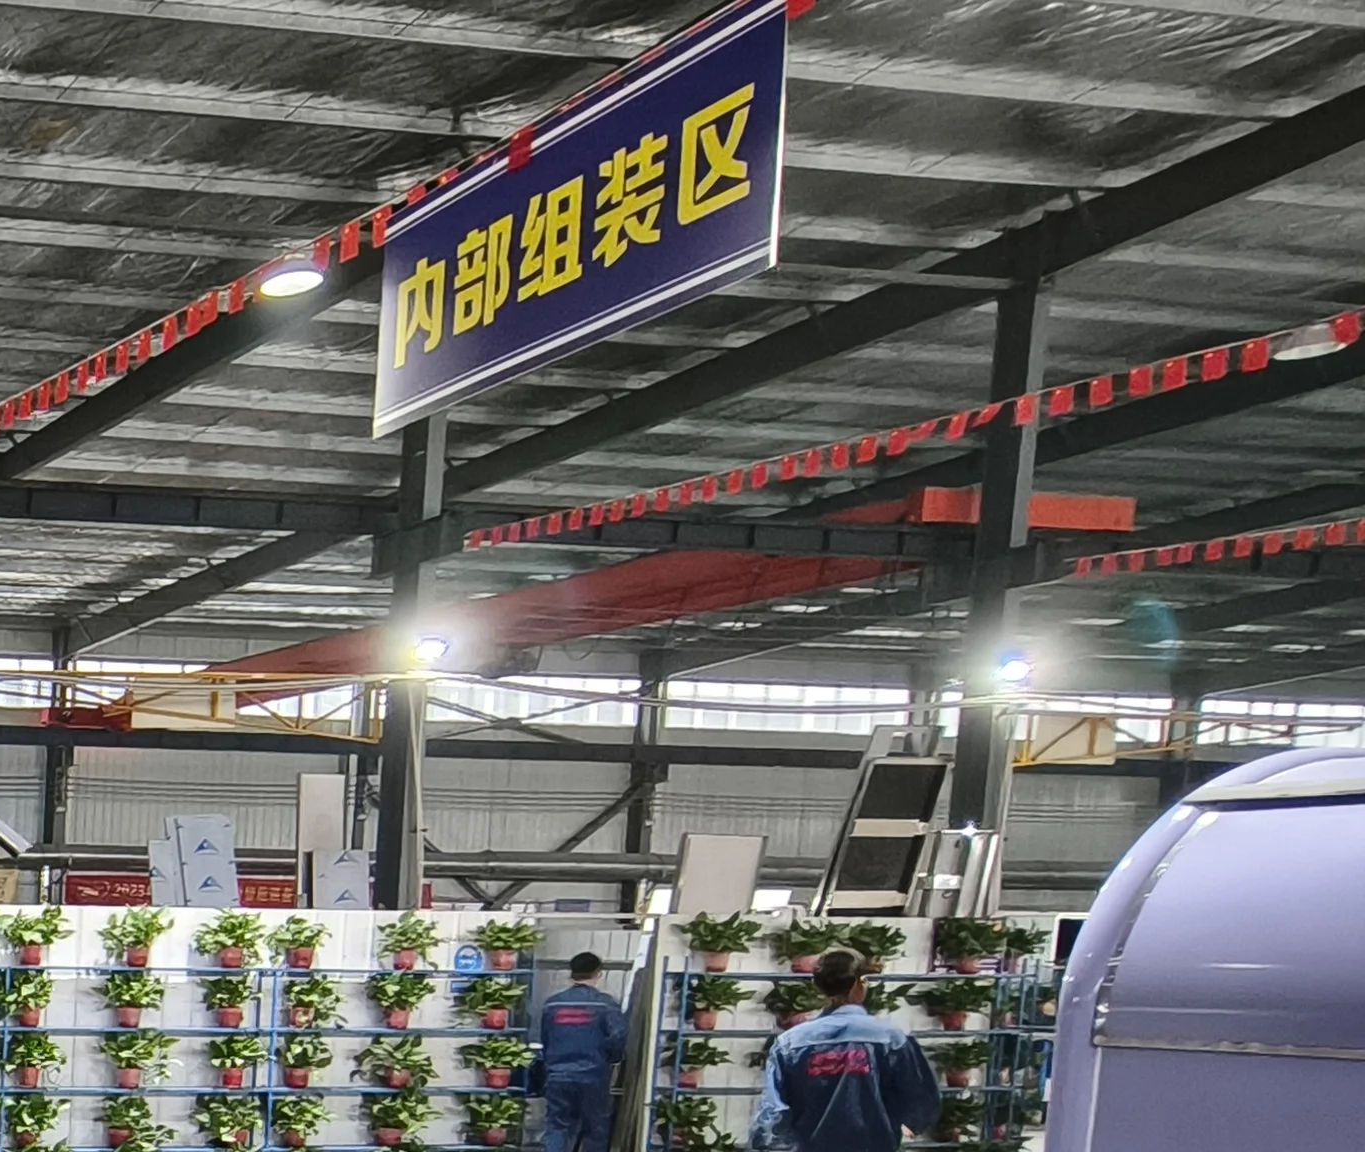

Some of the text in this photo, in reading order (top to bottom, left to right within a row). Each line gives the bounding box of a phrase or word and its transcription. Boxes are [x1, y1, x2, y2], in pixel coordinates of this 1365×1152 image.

[394, 82, 755, 369] 内部组装区
